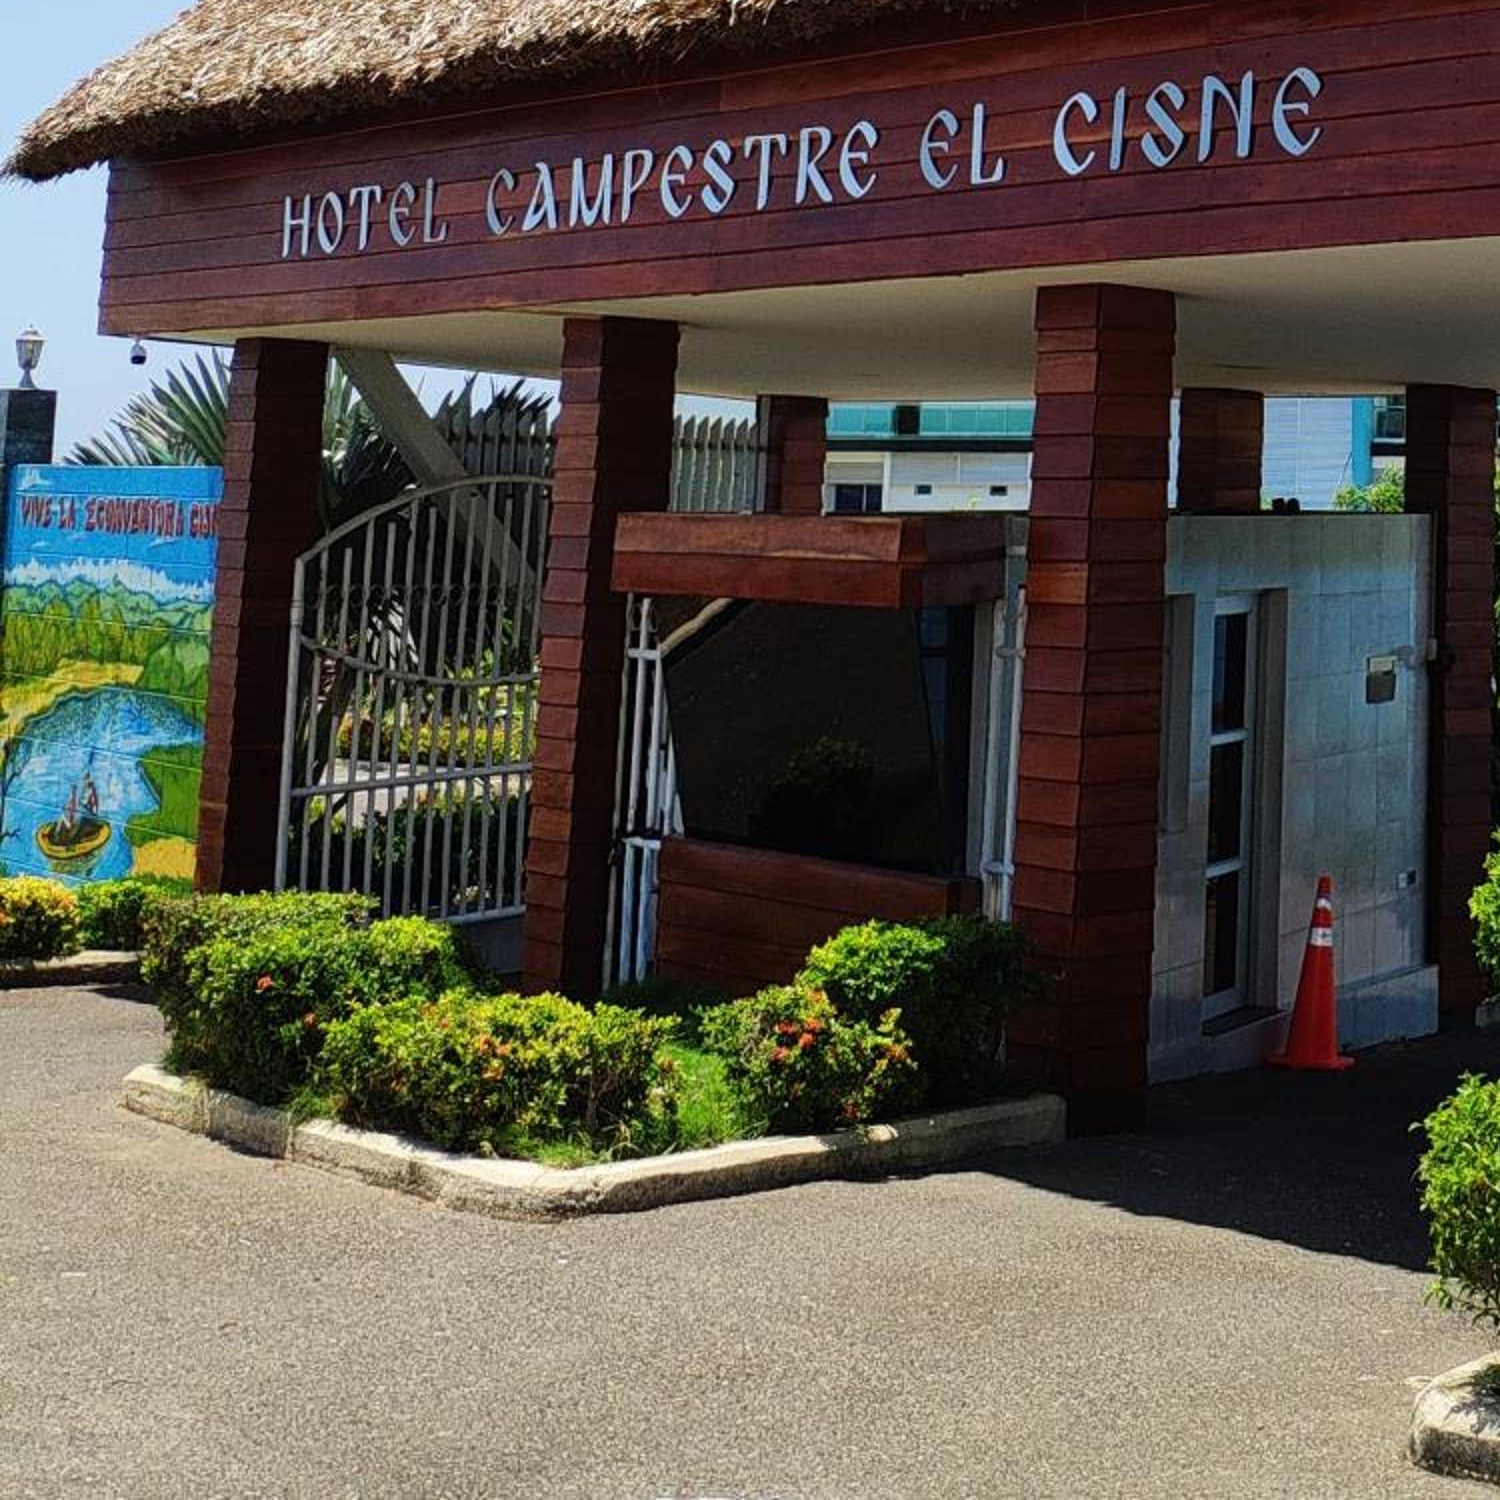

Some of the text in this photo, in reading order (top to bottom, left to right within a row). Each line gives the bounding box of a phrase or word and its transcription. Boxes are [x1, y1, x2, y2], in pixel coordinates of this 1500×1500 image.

[281, 66, 1323, 258] HOTEL CAMPESTRE EL CISNE
[21, 496, 51, 528] VIVE
